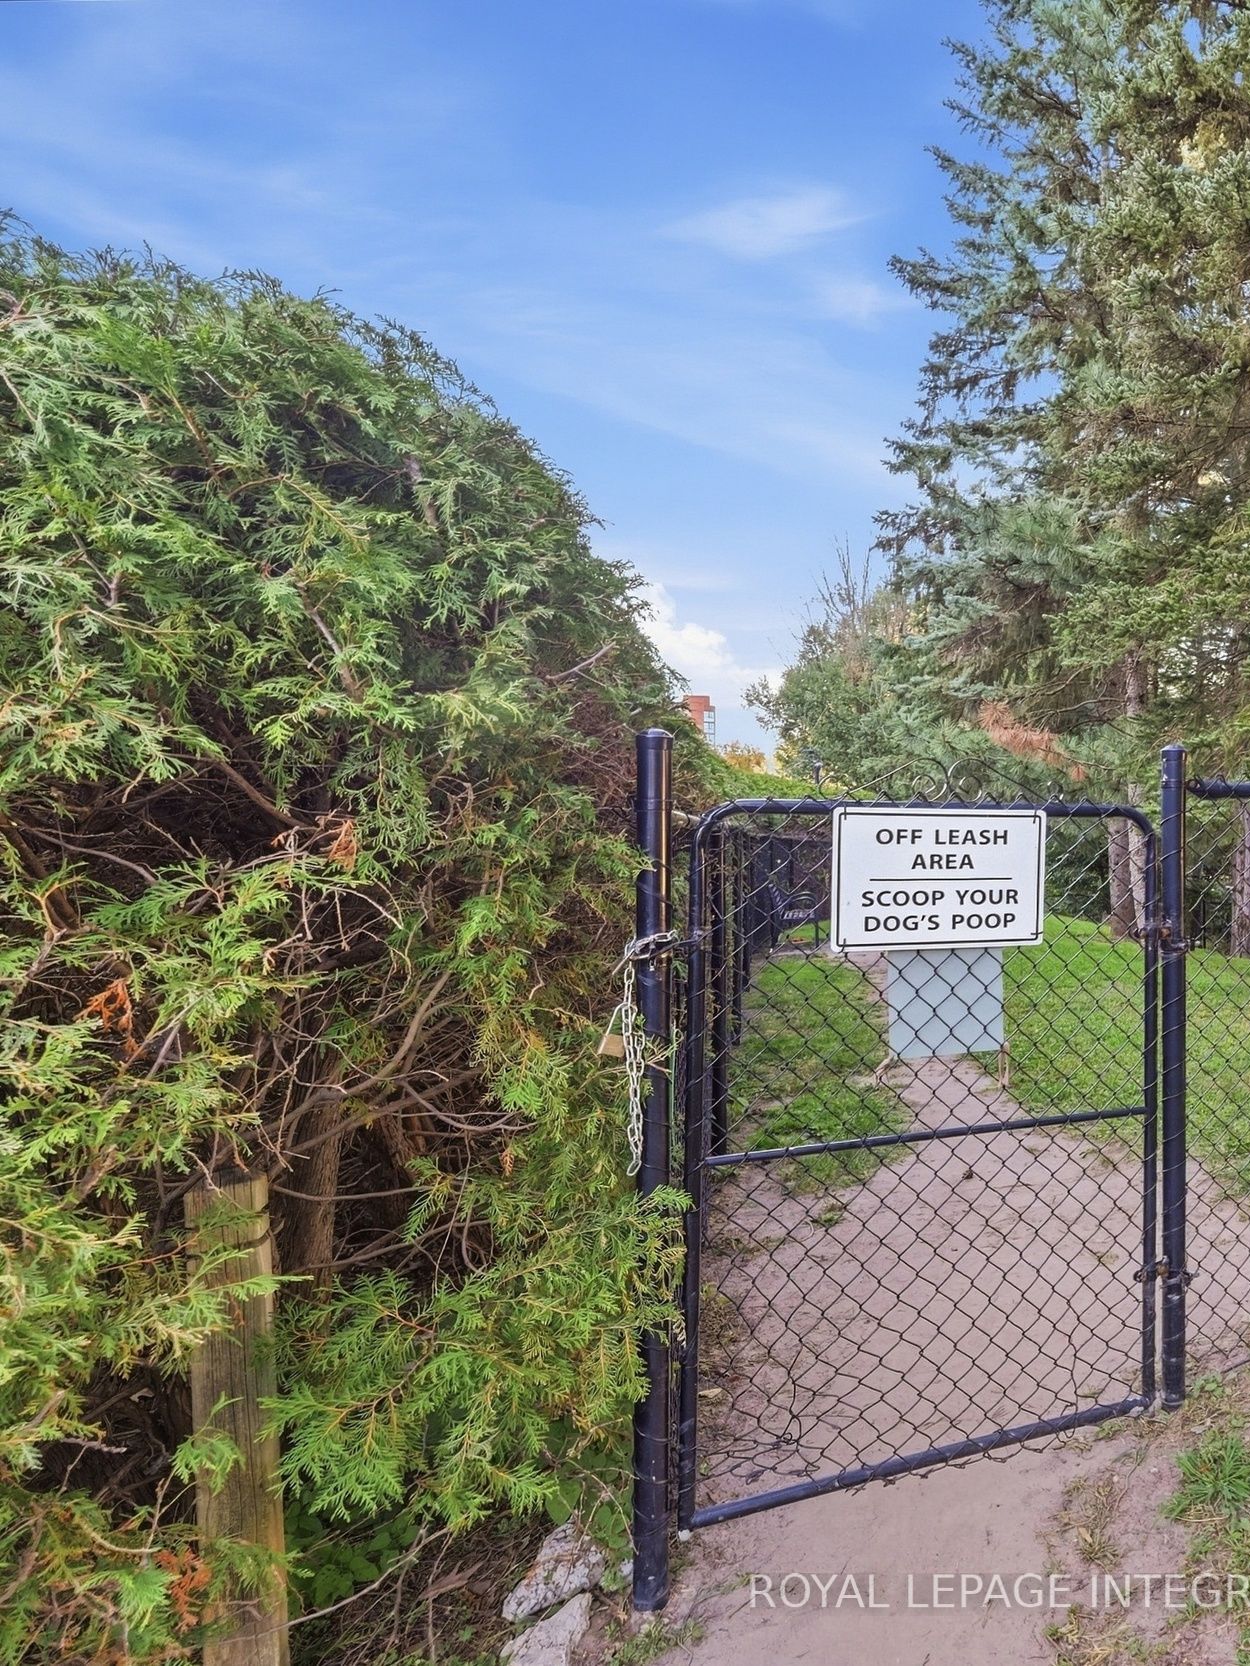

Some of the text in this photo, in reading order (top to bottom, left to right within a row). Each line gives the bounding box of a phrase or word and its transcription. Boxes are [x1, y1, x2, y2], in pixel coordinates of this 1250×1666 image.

[876, 828, 1009, 846] OFF LEASH
[911, 853, 975, 870] AREA
[861, 888, 1019, 908] SCOOP YOUR
[864, 912, 1016, 932] DOG'S POOP
